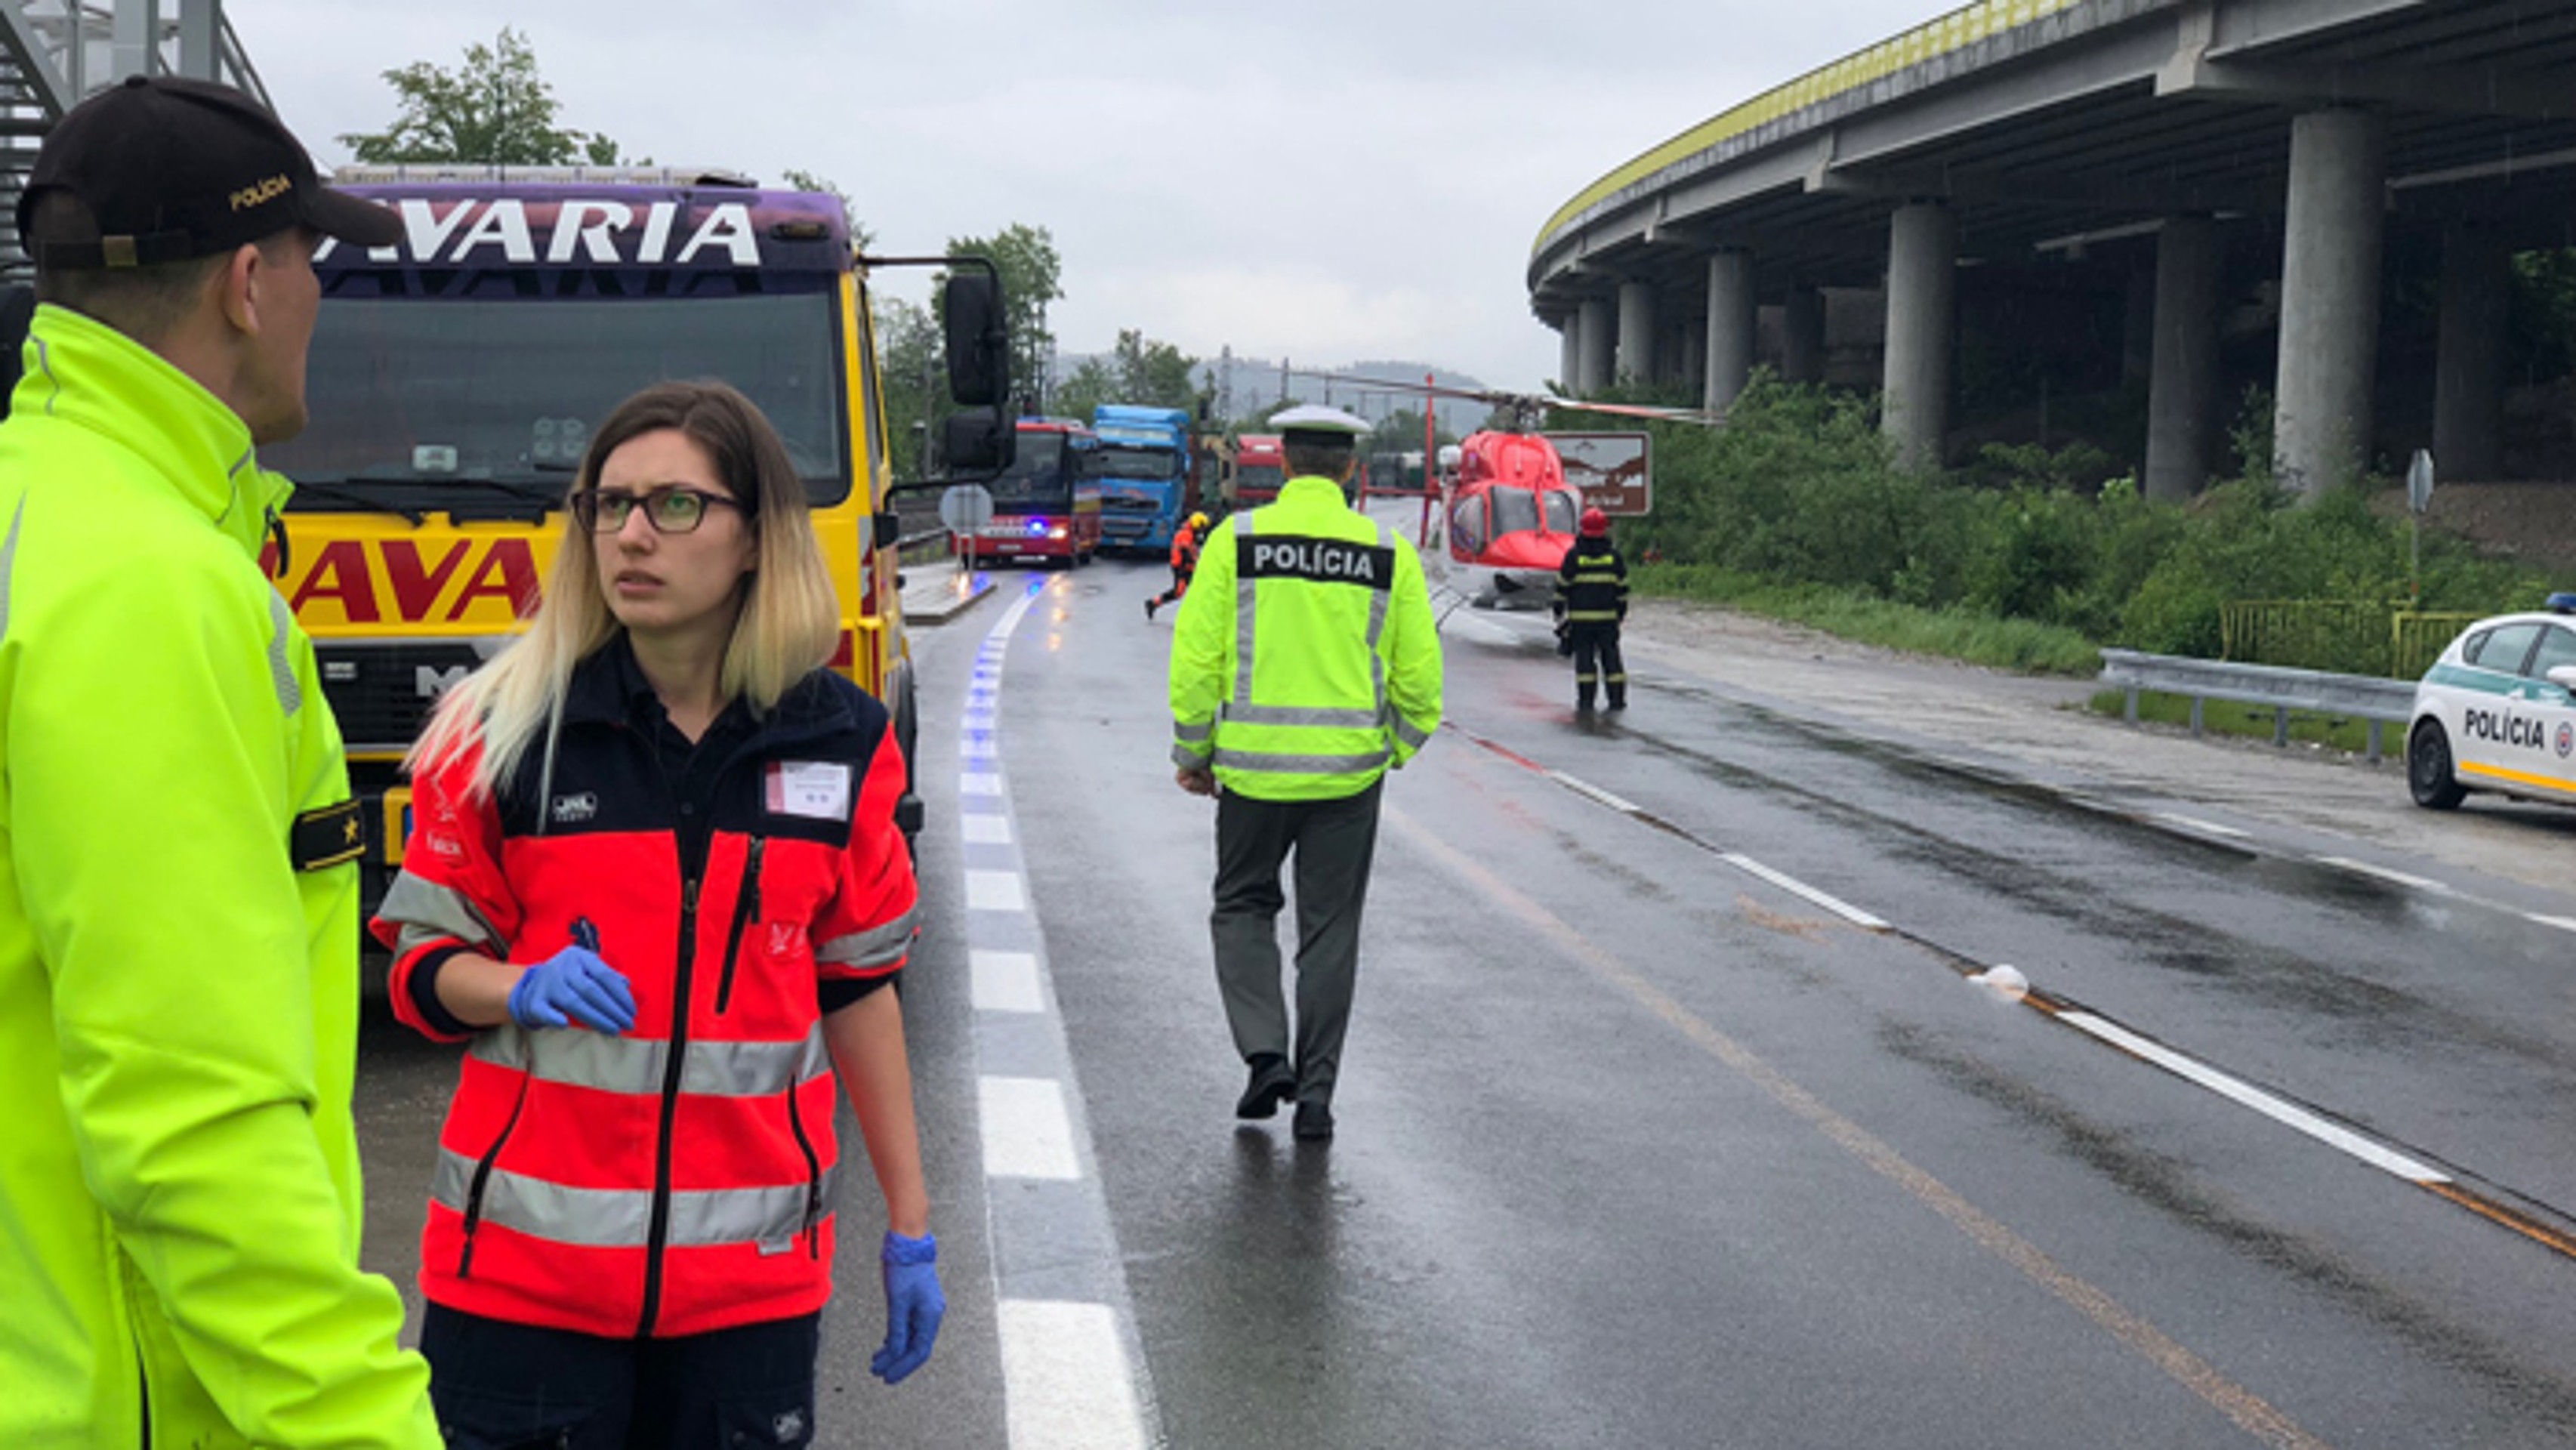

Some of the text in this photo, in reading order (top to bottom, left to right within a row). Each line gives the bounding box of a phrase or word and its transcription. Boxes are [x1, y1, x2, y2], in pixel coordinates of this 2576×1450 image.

[229, 173, 292, 211] POLÍCIA
[311, 198, 761, 267] VARIA
[1254, 542, 1374, 579] POLÍCIA
[2465, 707, 2544, 750] POLÍCIA
